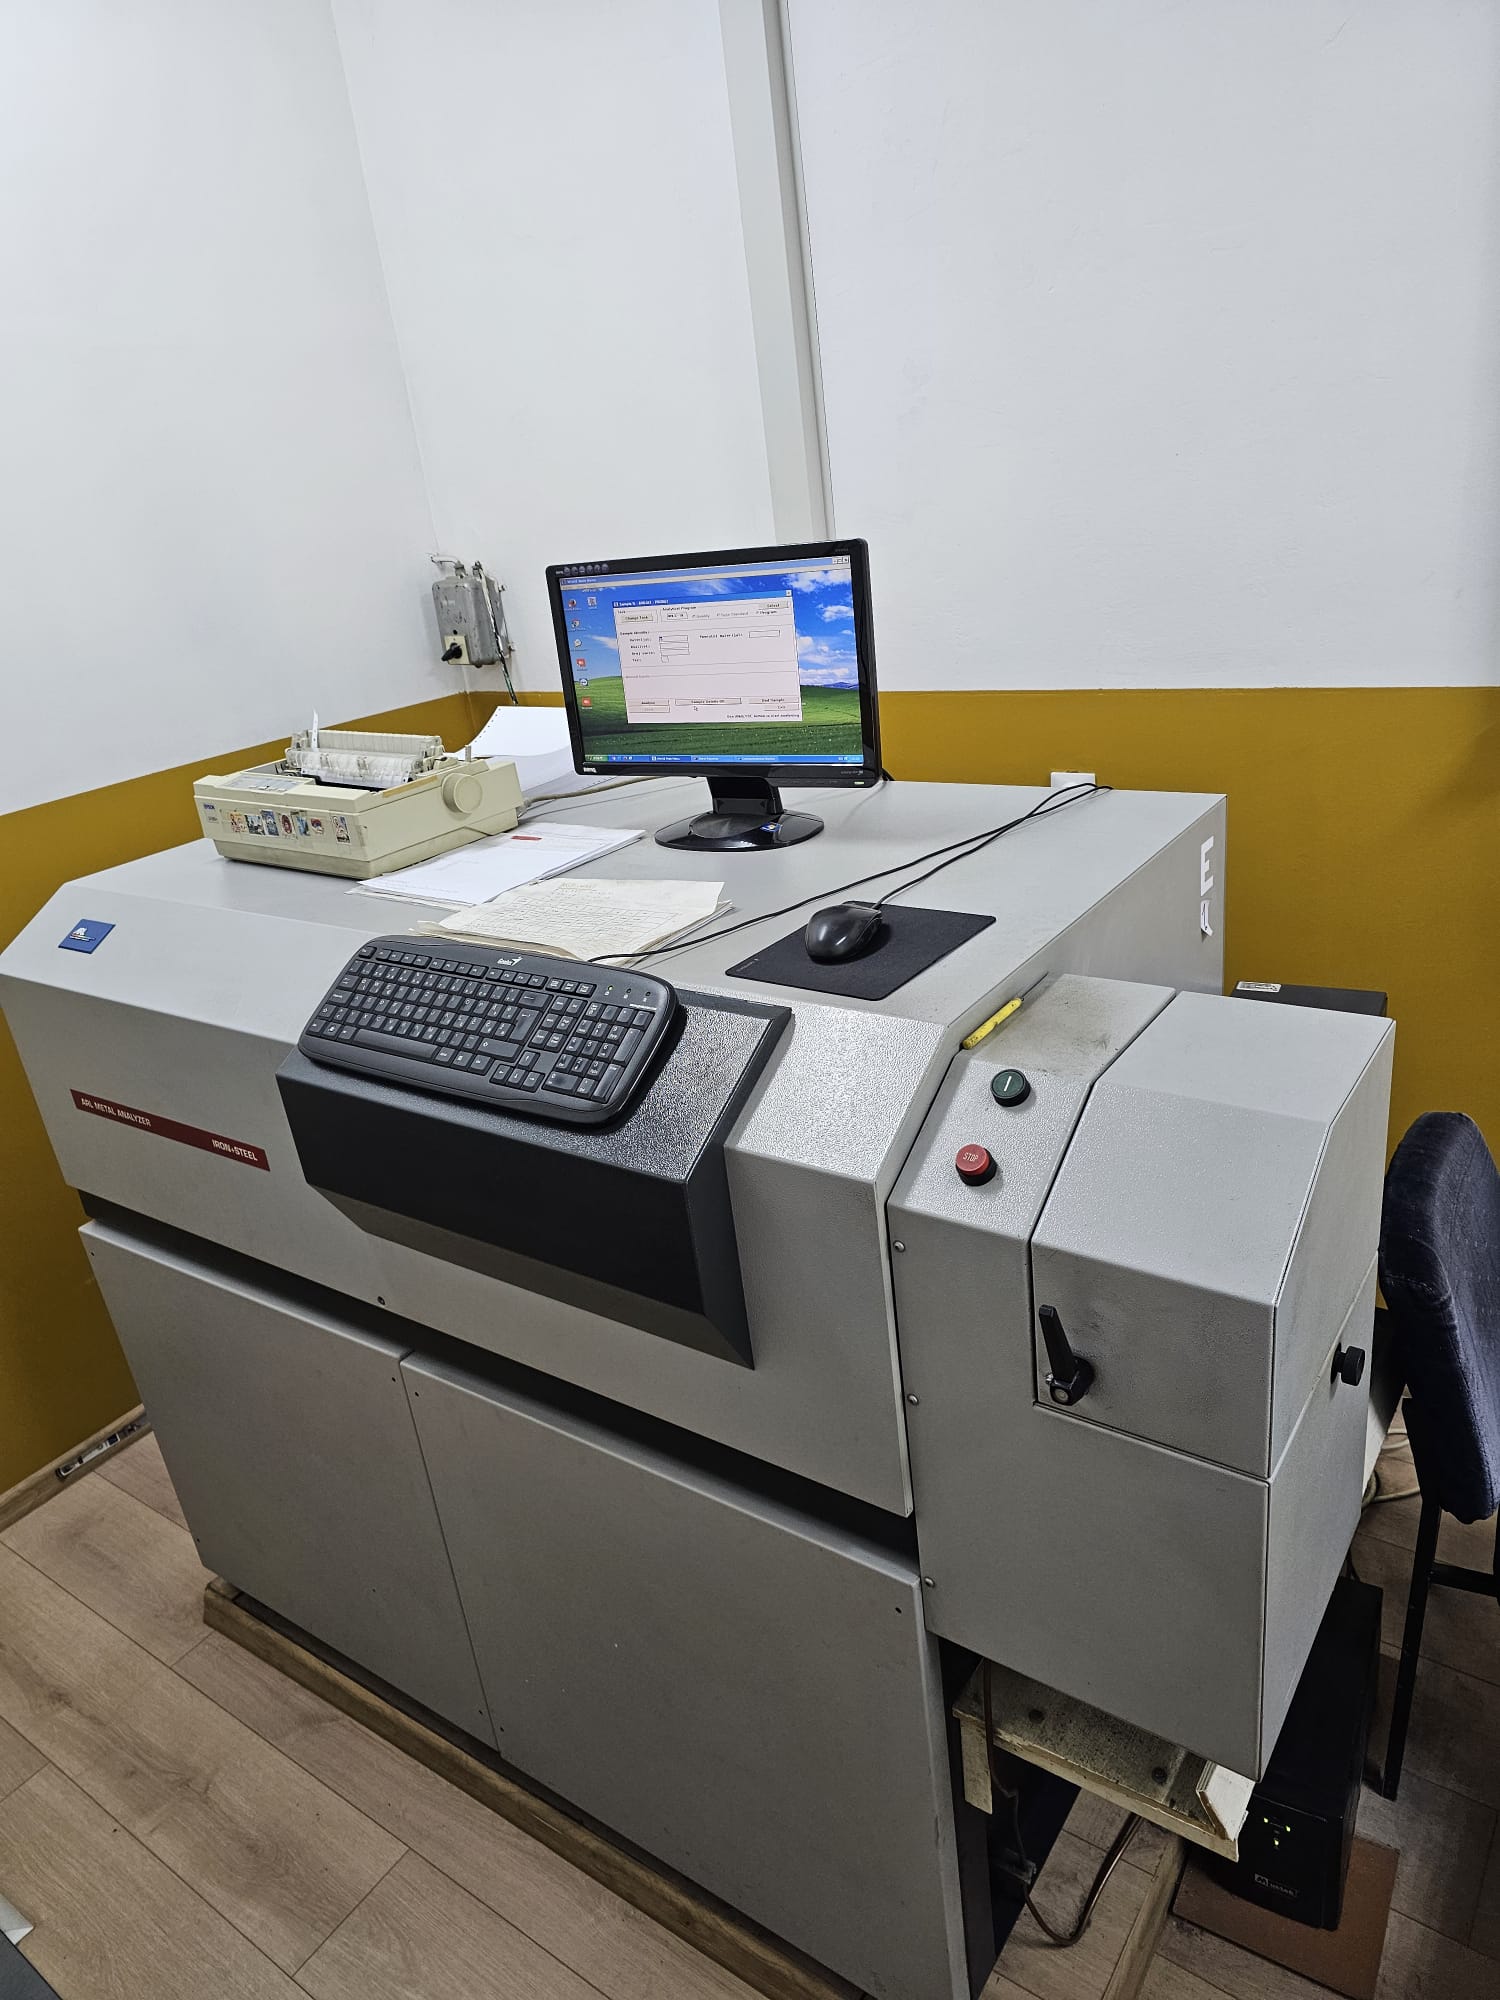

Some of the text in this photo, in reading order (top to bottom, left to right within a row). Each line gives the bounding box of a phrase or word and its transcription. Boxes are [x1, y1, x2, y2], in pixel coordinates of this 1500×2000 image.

[81, 1097, 152, 1127] ARL METAL ANALYZER
[962, 1152, 979, 1161] STOP
